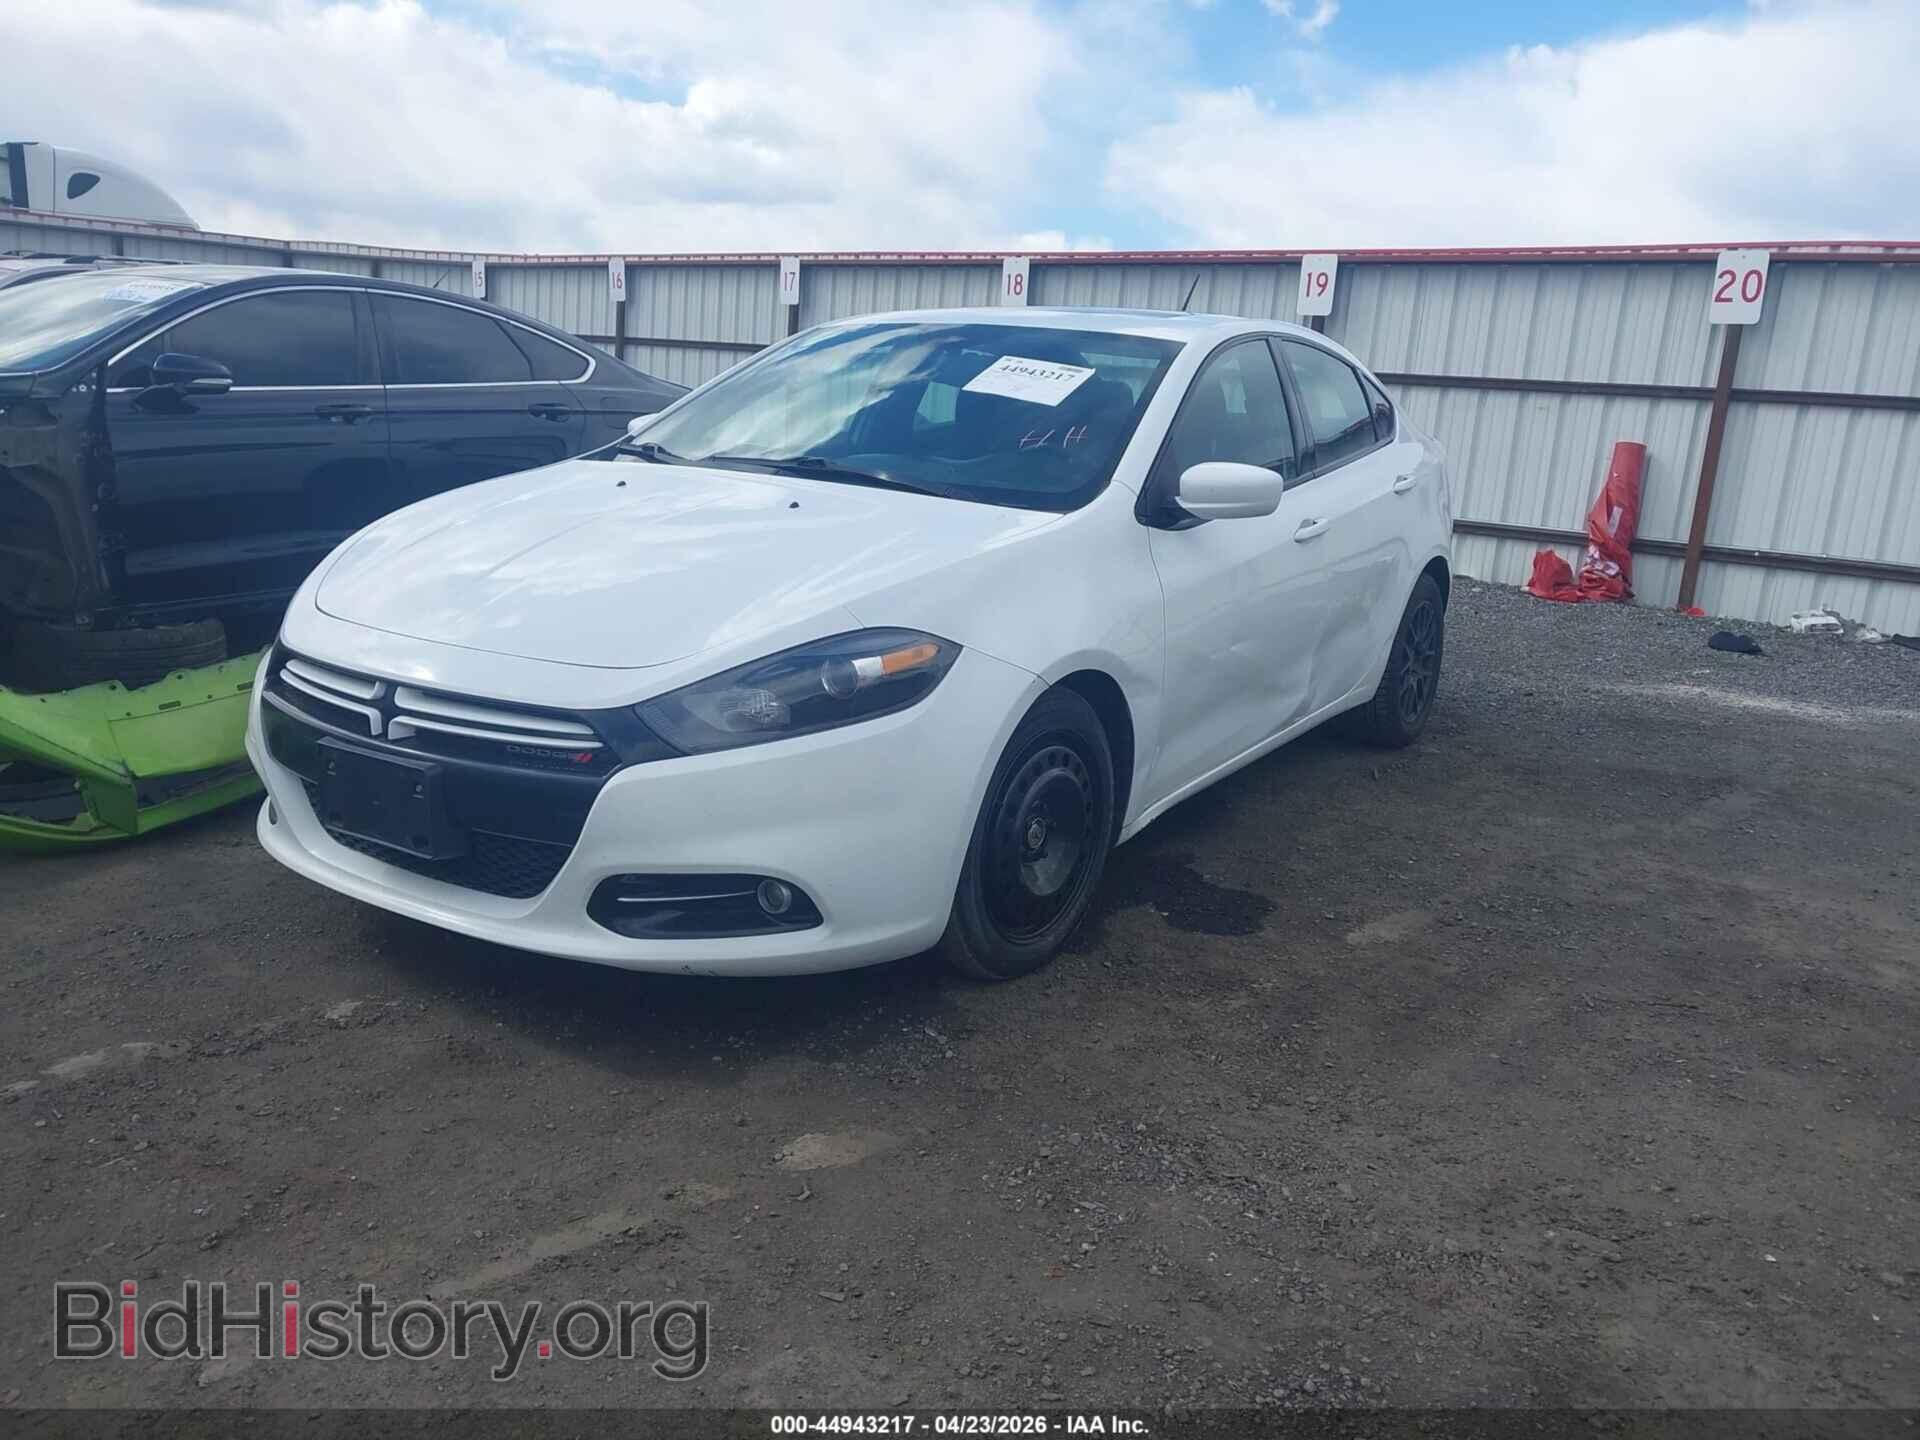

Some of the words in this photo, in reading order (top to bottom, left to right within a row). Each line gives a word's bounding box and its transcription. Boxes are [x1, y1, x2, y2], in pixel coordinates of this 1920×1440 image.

[611, 271, 623, 289] 16
[784, 271, 795, 291] 17
[1007, 273, 1023, 296] 18
[1306, 272, 1328, 297] 19
[1714, 269, 1763, 303] 20
[1000, 364, 1076, 382] 44943217
